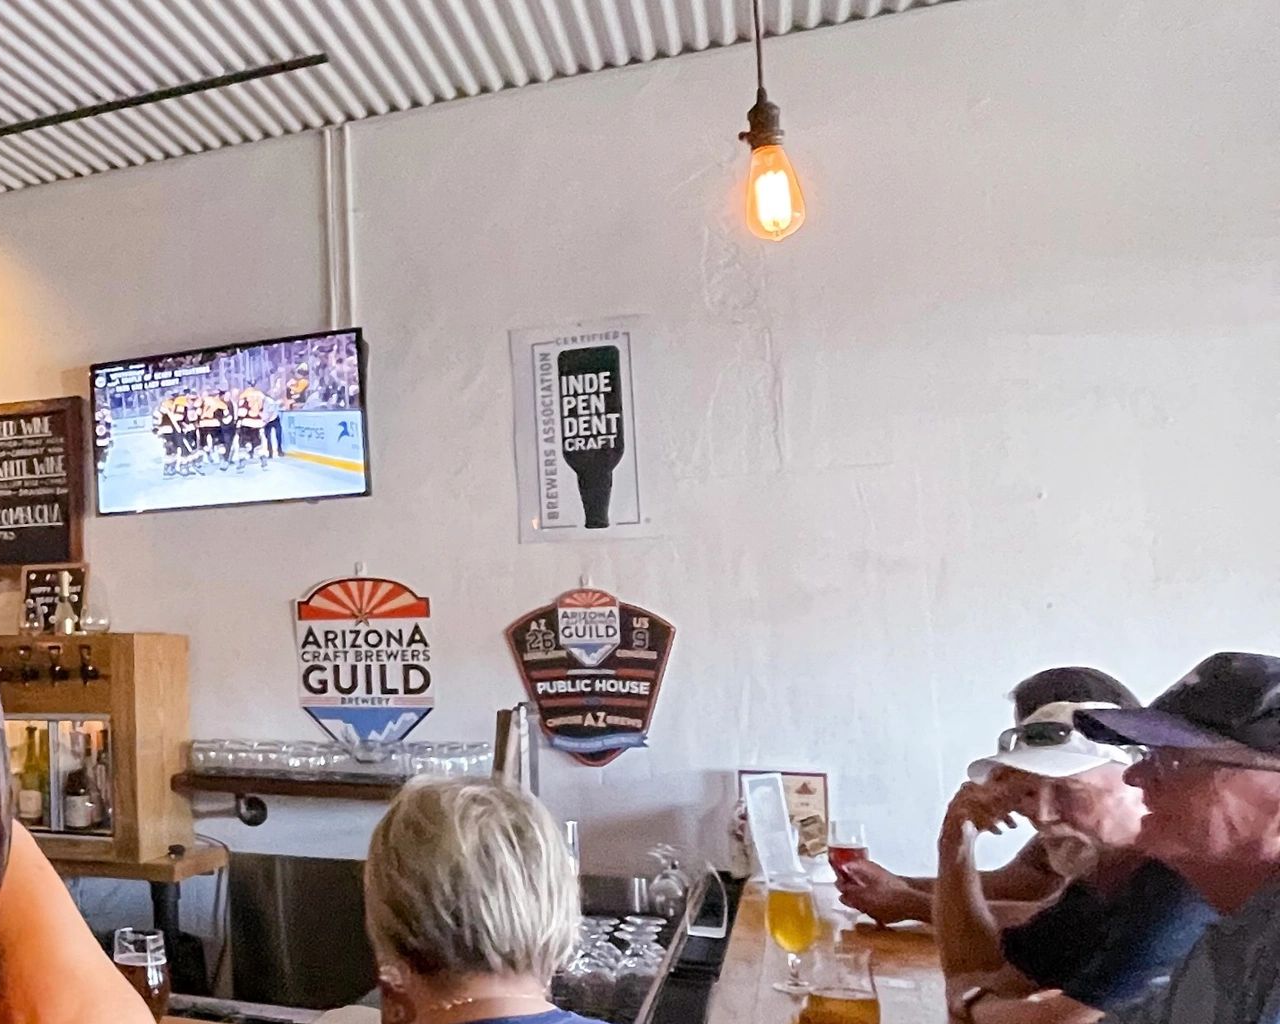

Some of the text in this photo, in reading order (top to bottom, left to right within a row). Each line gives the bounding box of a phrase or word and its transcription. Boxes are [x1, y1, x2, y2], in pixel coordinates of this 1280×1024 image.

[555, 330, 620, 346] CERTIFIED
[560, 372, 612, 395] INDE
[562, 394, 605, 416] PEN
[20, 416, 52, 435] WINE
[563, 413, 620, 437] DENT
[539, 352, 559, 520] BREWERS ASSOCIATION
[564, 435, 617, 452] CRAFT
[33, 454, 65, 476] WINE
[561, 609, 617, 619] ARIZONA
[301, 622, 430, 649] ARIZONA
[561, 625, 617, 639] GUILD
[301, 649, 431, 663] CRAFT BREWERS
[302, 664, 431, 695] GUILD
[536, 679, 651, 695] PUBLIC HOUSE
[340, 696, 391, 706] BREWERY
[583, 711, 607, 728] AZ
